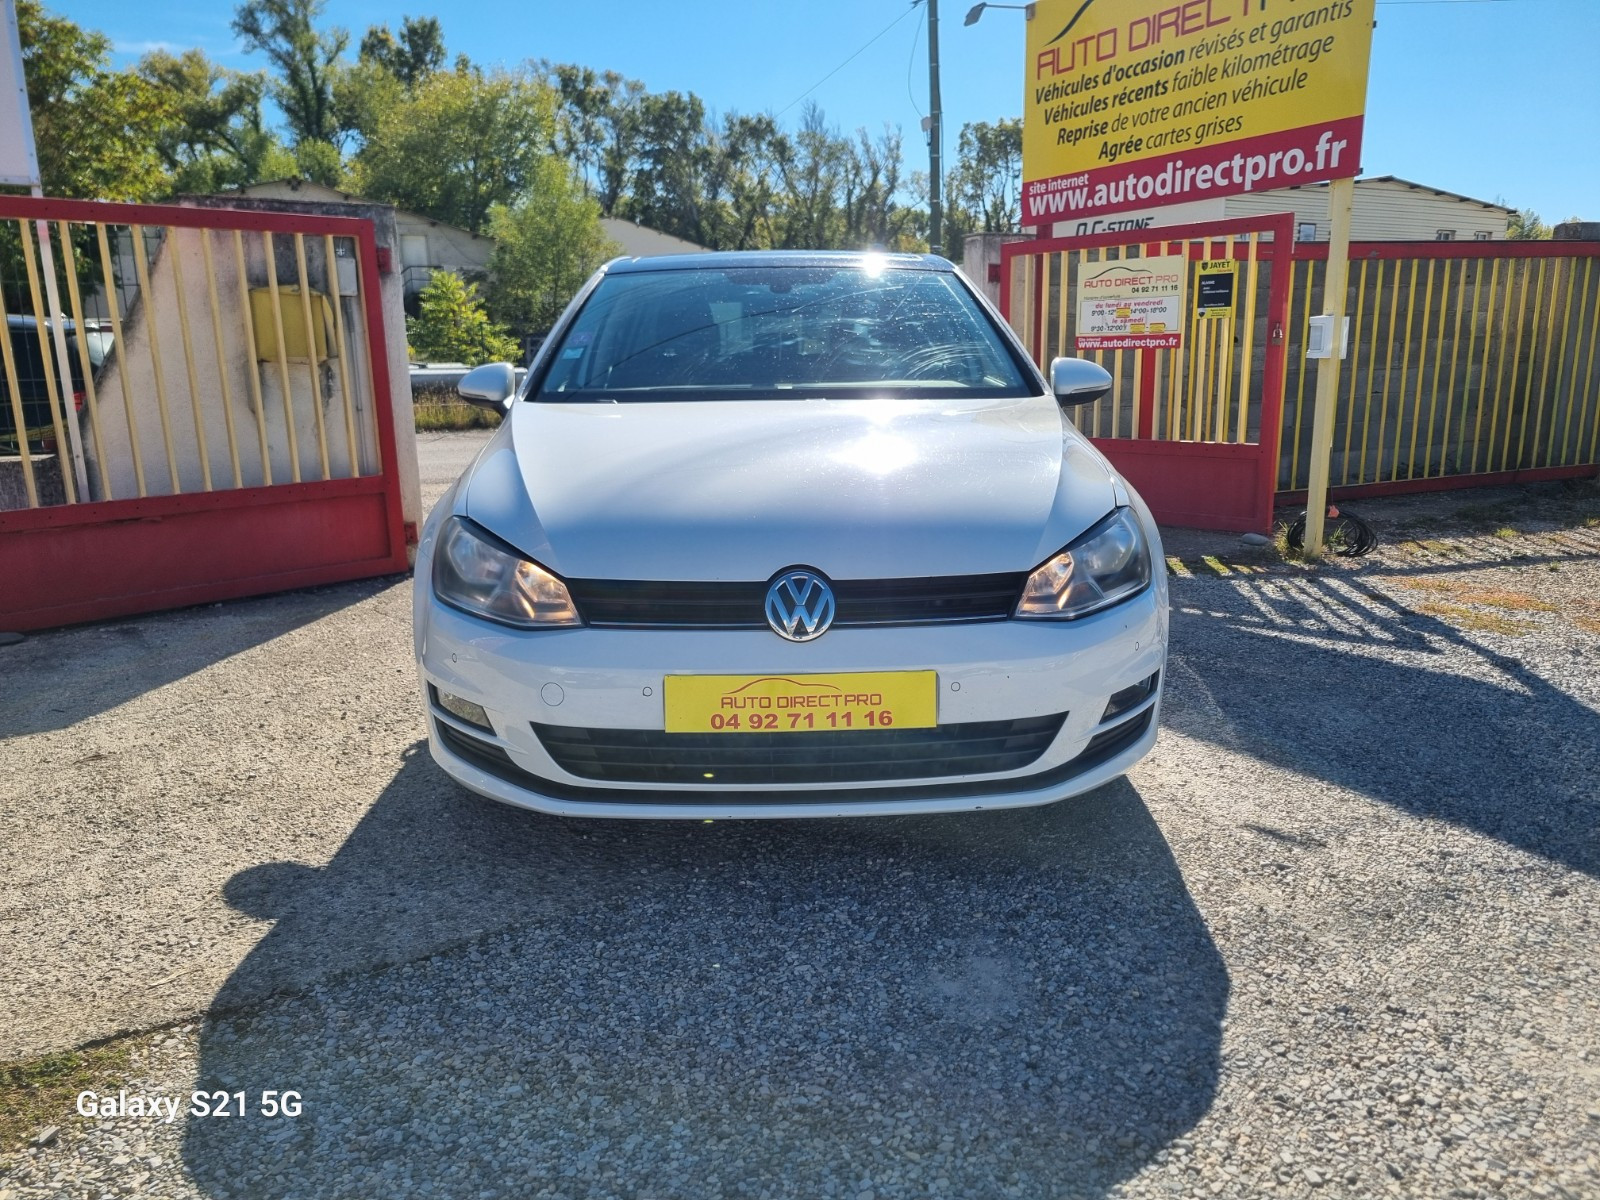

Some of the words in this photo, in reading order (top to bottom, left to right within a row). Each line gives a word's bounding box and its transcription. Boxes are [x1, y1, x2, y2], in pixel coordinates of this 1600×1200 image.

[1036, 74, 1100, 105] Véhicules
[1102, 49, 1185, 86] d'occasion
[1188, 28, 1245, 62] révisés
[1249, 22, 1268, 44] et
[1269, 0, 1353, 44] garantis
[1037, 28, 1118, 80] AUTO
[1044, 95, 1109, 125] Véhicules
[1112, 79, 1169, 108] récents
[1171, 63, 1218, 93] faible
[1220, 35, 1335, 80] kilométrage
[1057, 120, 1109, 147] Reprise
[1111, 113, 1129, 133] de
[1132, 105, 1170, 128] votre
[1172, 91, 1227, 119] ancien
[1232, 68, 1308, 104] véhicule
[1098, 135, 1143, 162] Agrée
[1146, 126, 1193, 150] cartes
[1194, 115, 1244, 145] grises
[1028, 131, 1348, 217] www.autodirectpro.fr
[1028, 182, 1047, 195] site
[1047, 173, 1089, 192] internet
[1083, 279, 1112, 288] AUTO
[1114, 276, 1153, 287] DIRECT
[1155, 274, 1179, 284] PRO
[1209, 261, 1231, 269] JAYET
[1133, 299, 1163, 307] vendredi
[1078, 337, 1178, 348] www.autodirectpro.fr
[765, 571, 835, 642] VW
[721, 695, 771, 709] AUTO
[776, 694, 842, 708] DIRECT
[844, 693, 882, 706] PRO
[710, 713, 740, 730] 04
[748, 713, 778, 729] 92
[787, 712, 814, 729] 71
[826, 711, 852, 728] 11
[863, 710, 893, 727] 16
